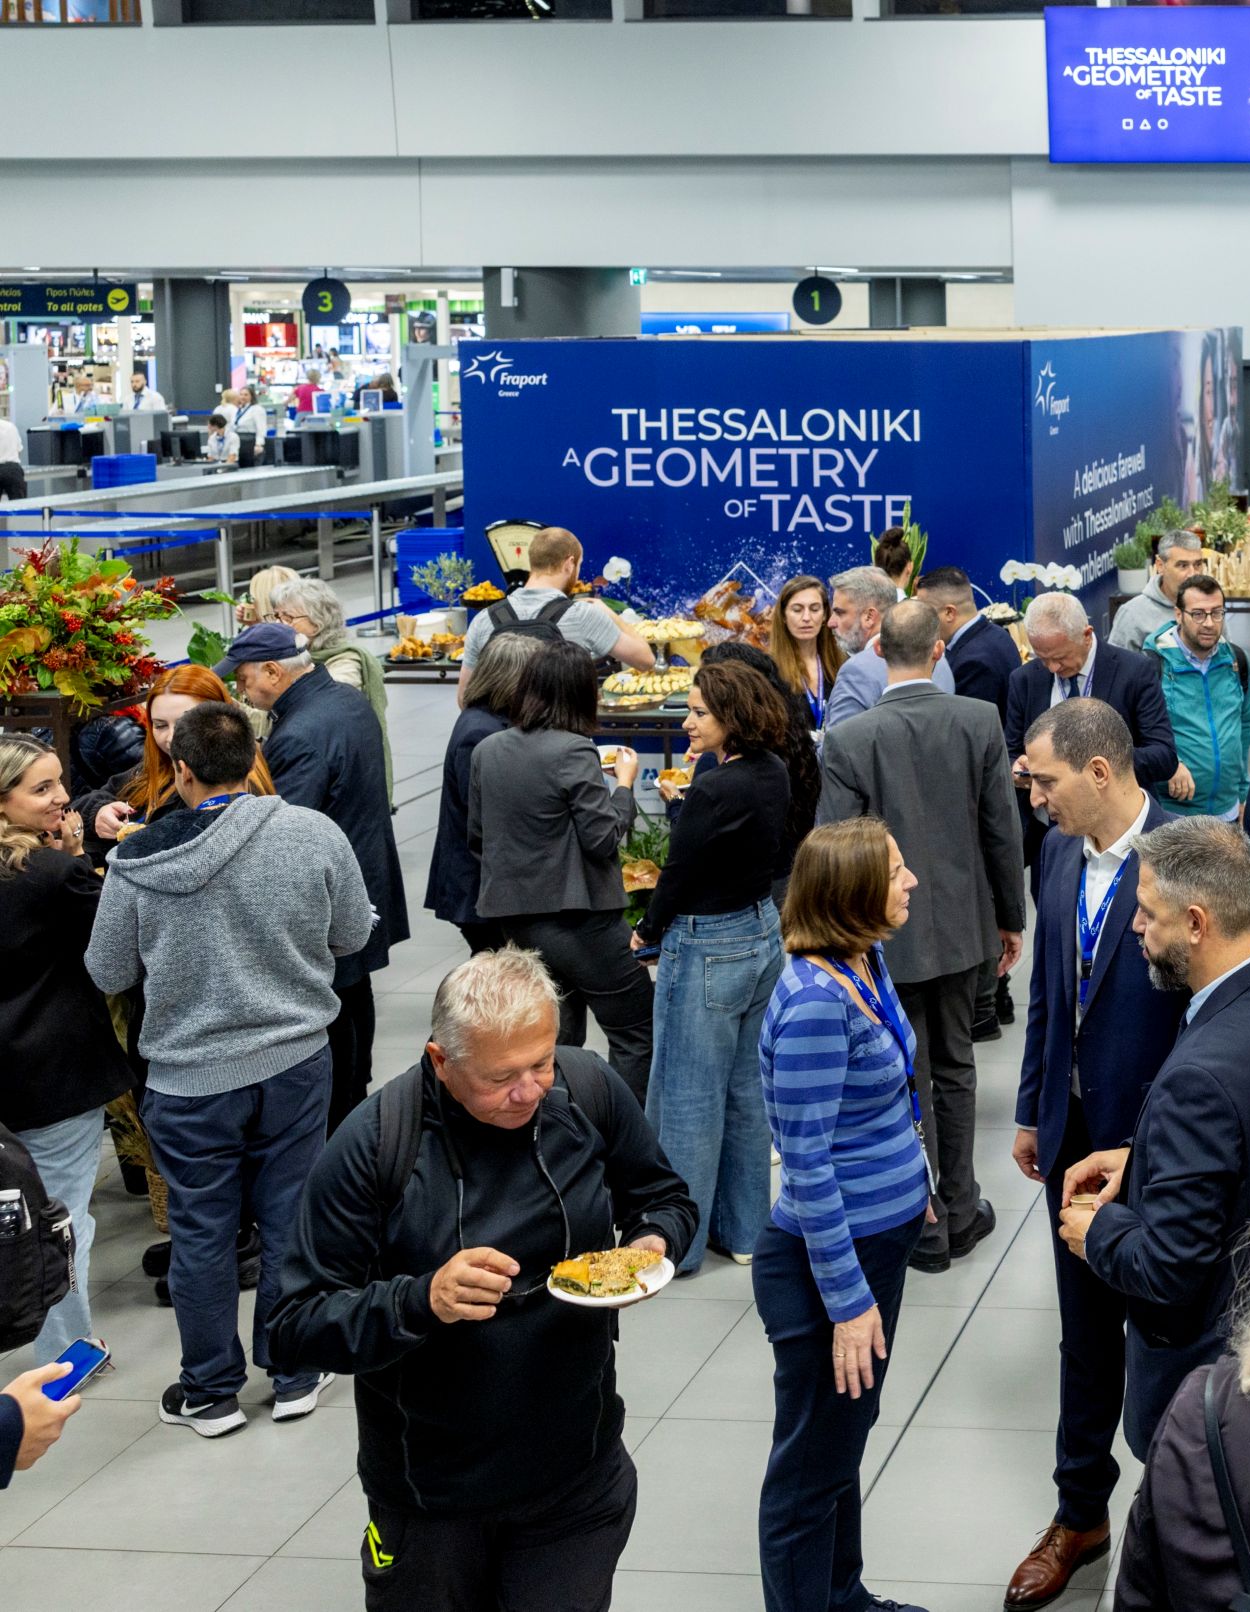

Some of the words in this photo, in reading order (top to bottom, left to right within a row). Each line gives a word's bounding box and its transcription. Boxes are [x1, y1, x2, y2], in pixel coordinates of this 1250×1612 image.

[1084, 47, 1226, 65] THESSALONIKI
[1063, 65, 1073, 77] A
[1072, 65, 1207, 86] GEOMETRY
[1135, 89, 1152, 100] OF
[1152, 87, 1223, 106] TASTE
[46, 301, 58, 312] To
[60, 301, 74, 312] all
[76, 302, 104, 314] gates
[317, 291, 334, 313] 3
[810, 290, 821, 312] 1
[499, 372, 549, 390] Fraport
[497, 389, 520, 398] Greece
[611, 408, 921, 442] THESSALONIKI
[562, 447, 581, 467] A
[583, 447, 879, 488] GEOMETRY
[1073, 469, 1082, 499] A
[1081, 458, 1118, 495] delicious
[1118, 444, 1146, 480] farewell
[724, 499, 757, 518] OF
[760, 494, 912, 532] TASTE
[1062, 513, 1084, 550] with
[1137, 483, 1154, 512] most
